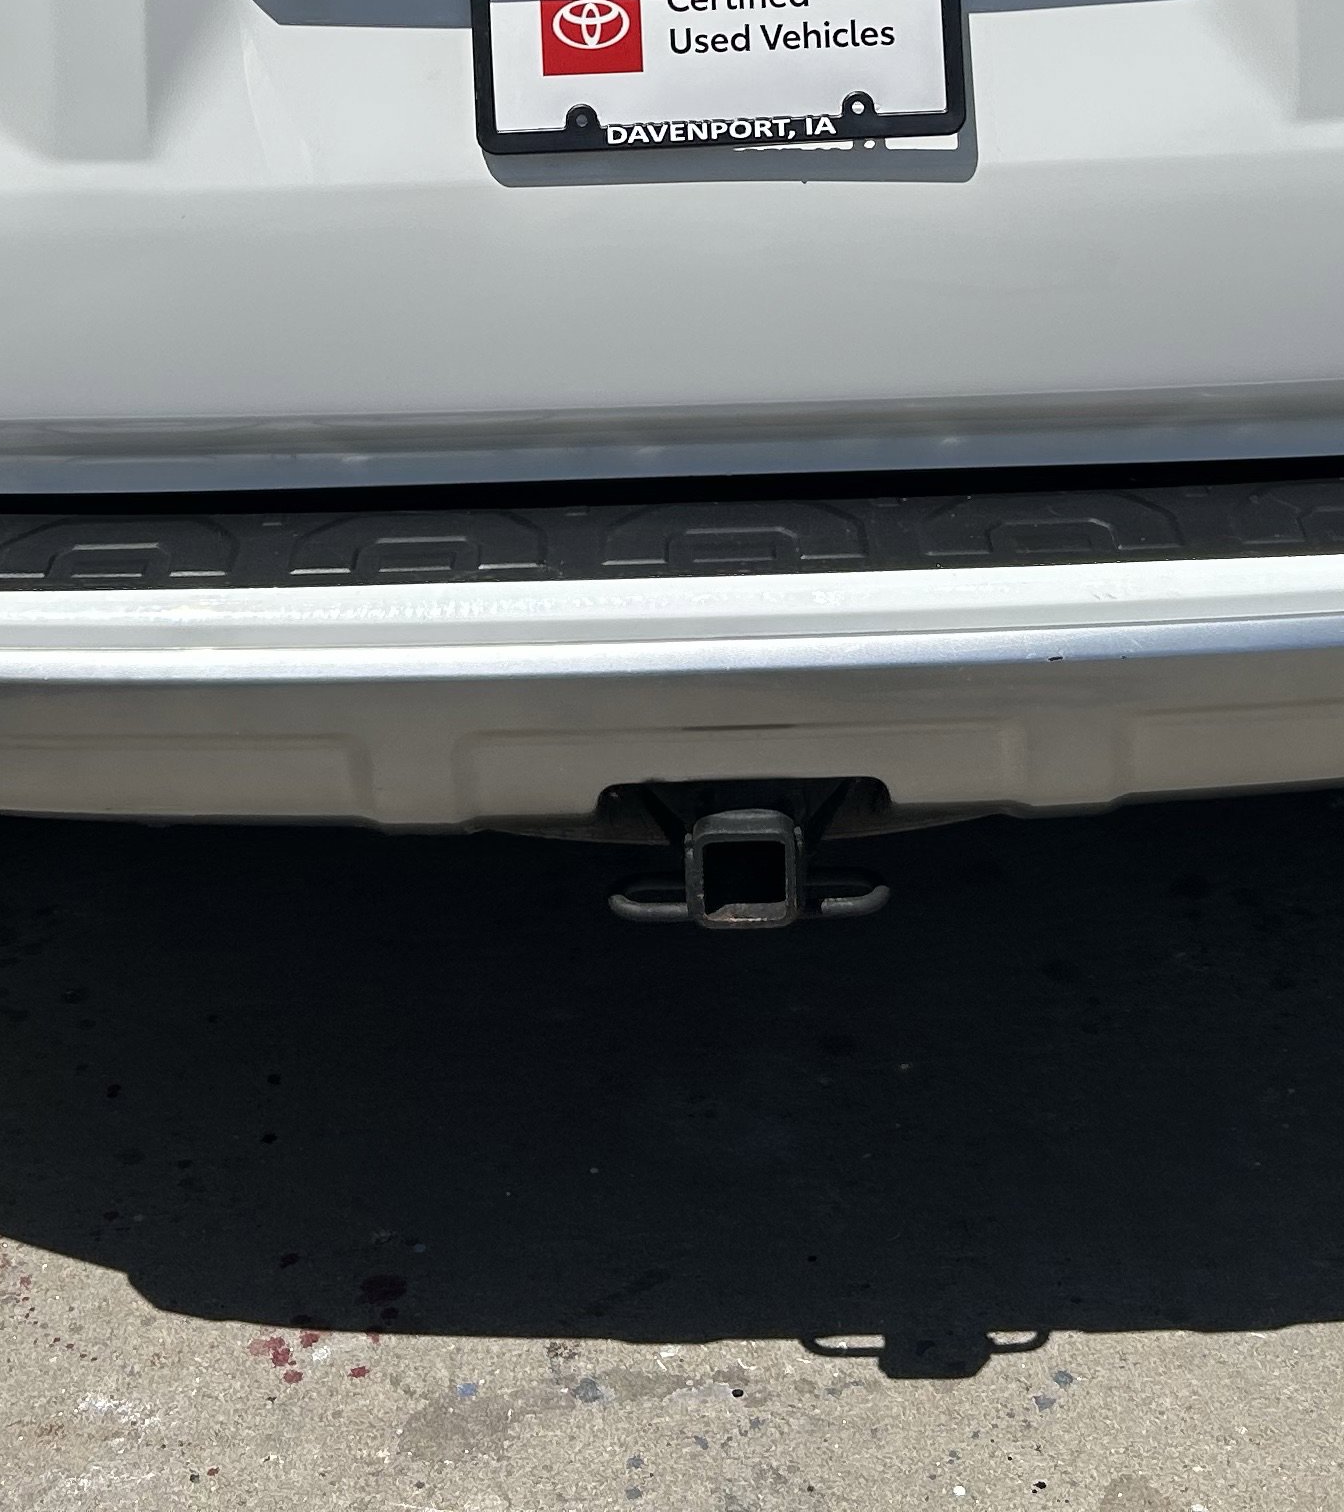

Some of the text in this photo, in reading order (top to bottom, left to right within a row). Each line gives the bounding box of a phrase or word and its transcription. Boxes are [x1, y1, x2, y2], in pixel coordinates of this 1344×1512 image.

[668, 19, 896, 55] Used Vehicles
[606, 116, 837, 146] DAVENPORT, IA
